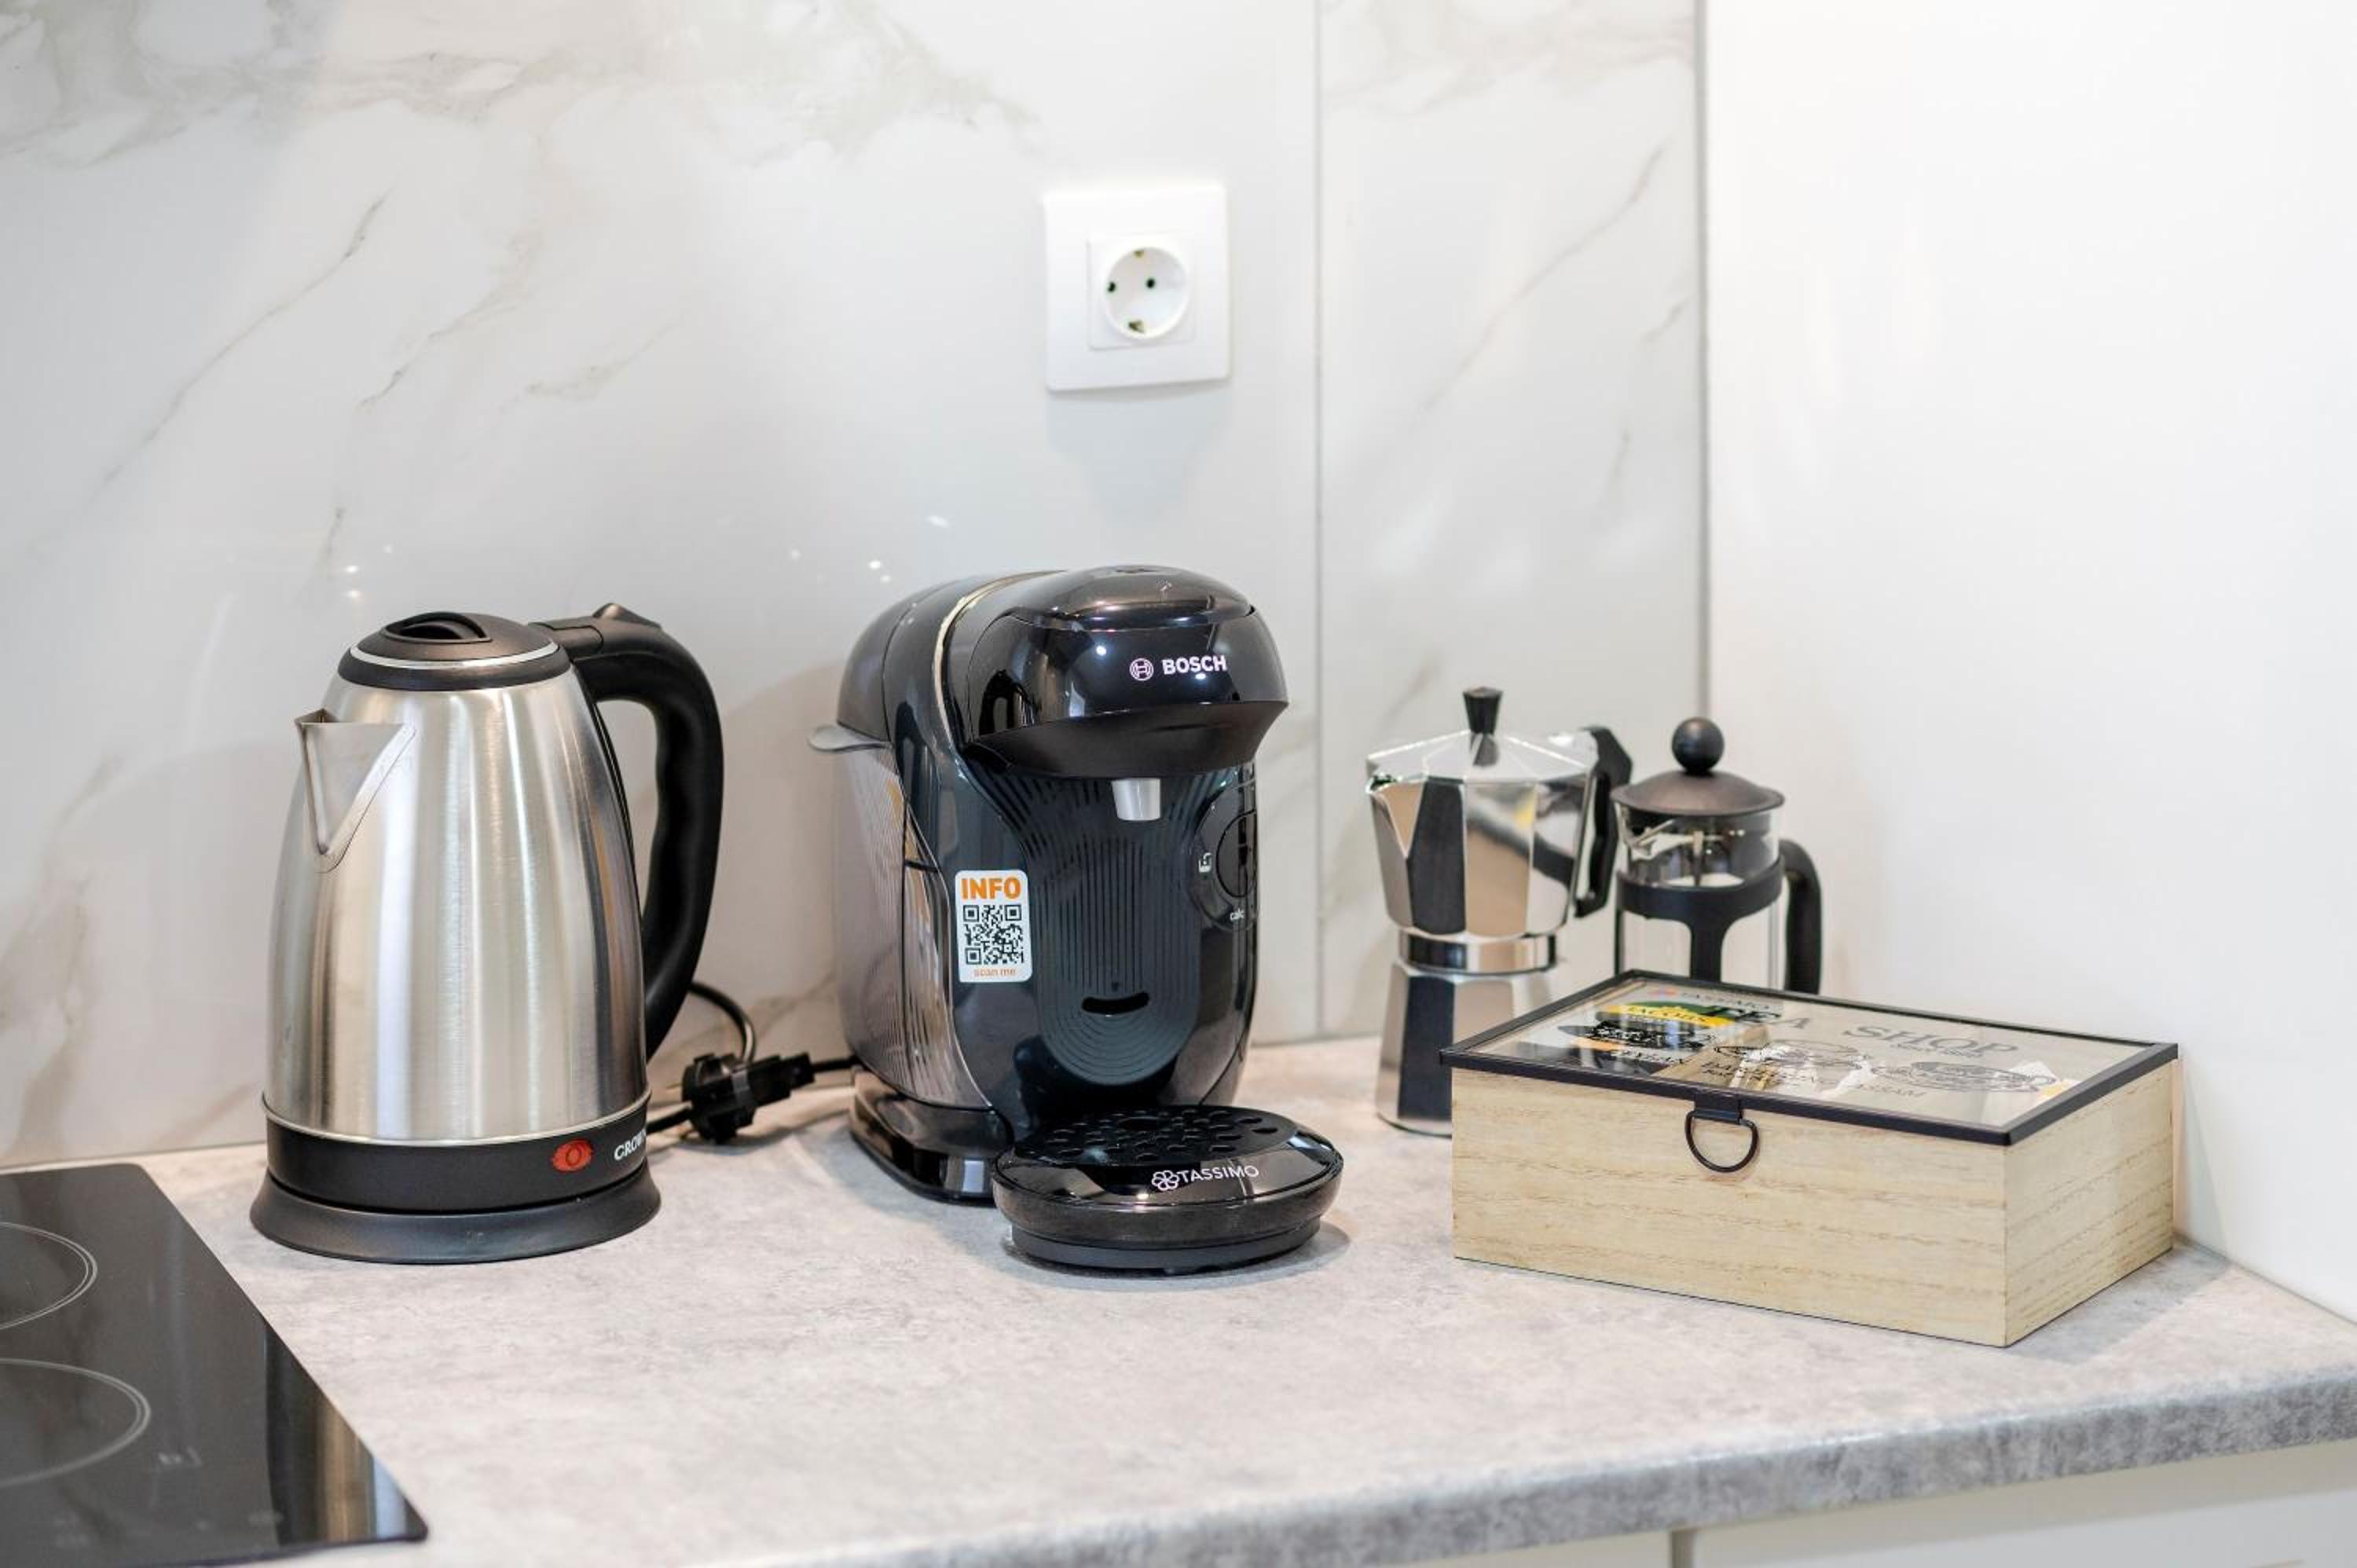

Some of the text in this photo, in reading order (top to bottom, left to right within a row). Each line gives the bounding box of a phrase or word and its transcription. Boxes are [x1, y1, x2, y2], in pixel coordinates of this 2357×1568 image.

[1162, 654, 1227, 675] BOSCH
[961, 877, 1021, 899] INFO
[973, 968, 1016, 977] scan me
[1843, 1025, 2019, 1054] SHOP
[1177, 1165, 1259, 1183] TASSIMO
